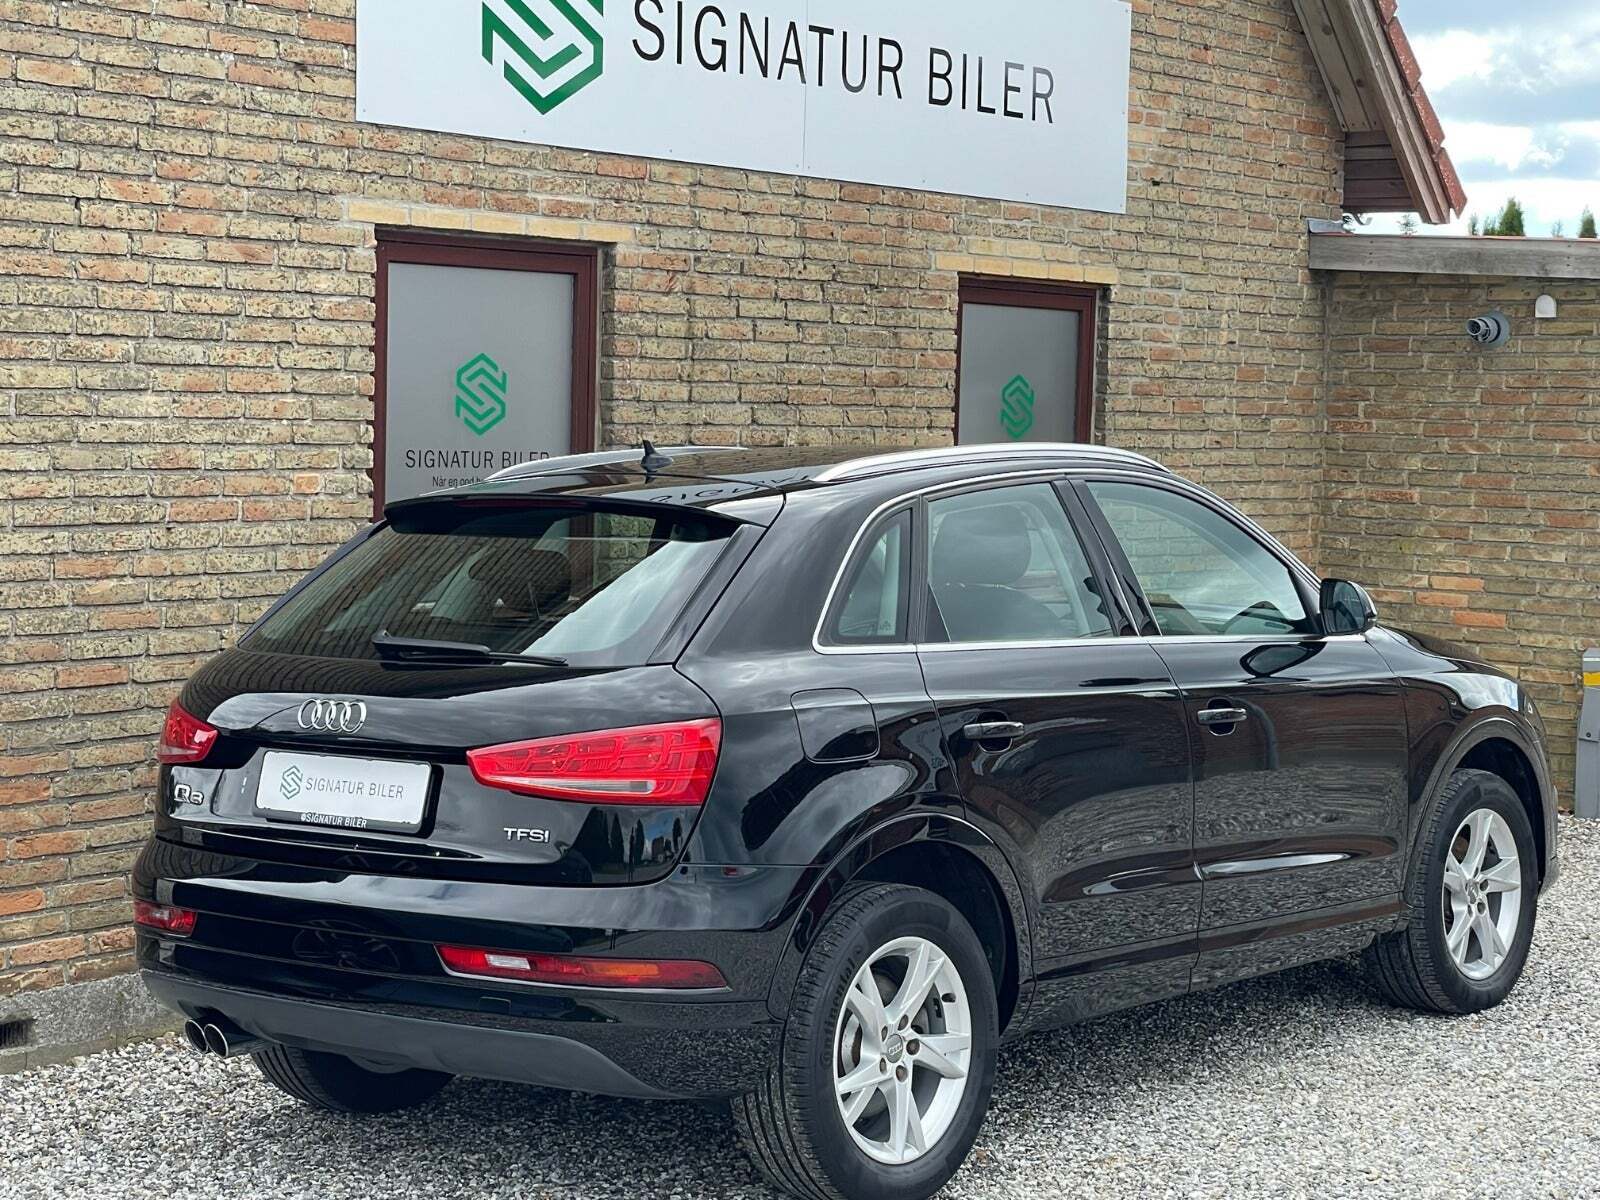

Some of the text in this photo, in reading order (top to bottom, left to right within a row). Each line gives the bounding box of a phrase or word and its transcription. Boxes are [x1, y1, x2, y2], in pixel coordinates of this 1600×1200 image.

[632, 0, 1054, 124] SIGNATUR BILER
[405, 450, 494, 469] SIGNATUR
[432, 475, 446, 487] Når
[174, 784, 204, 805] Q3
[305, 777, 404, 799] SIGNATUR BILER
[305, 813, 367, 828] SIGNATUR BILER
[503, 827, 550, 843] TFSI
